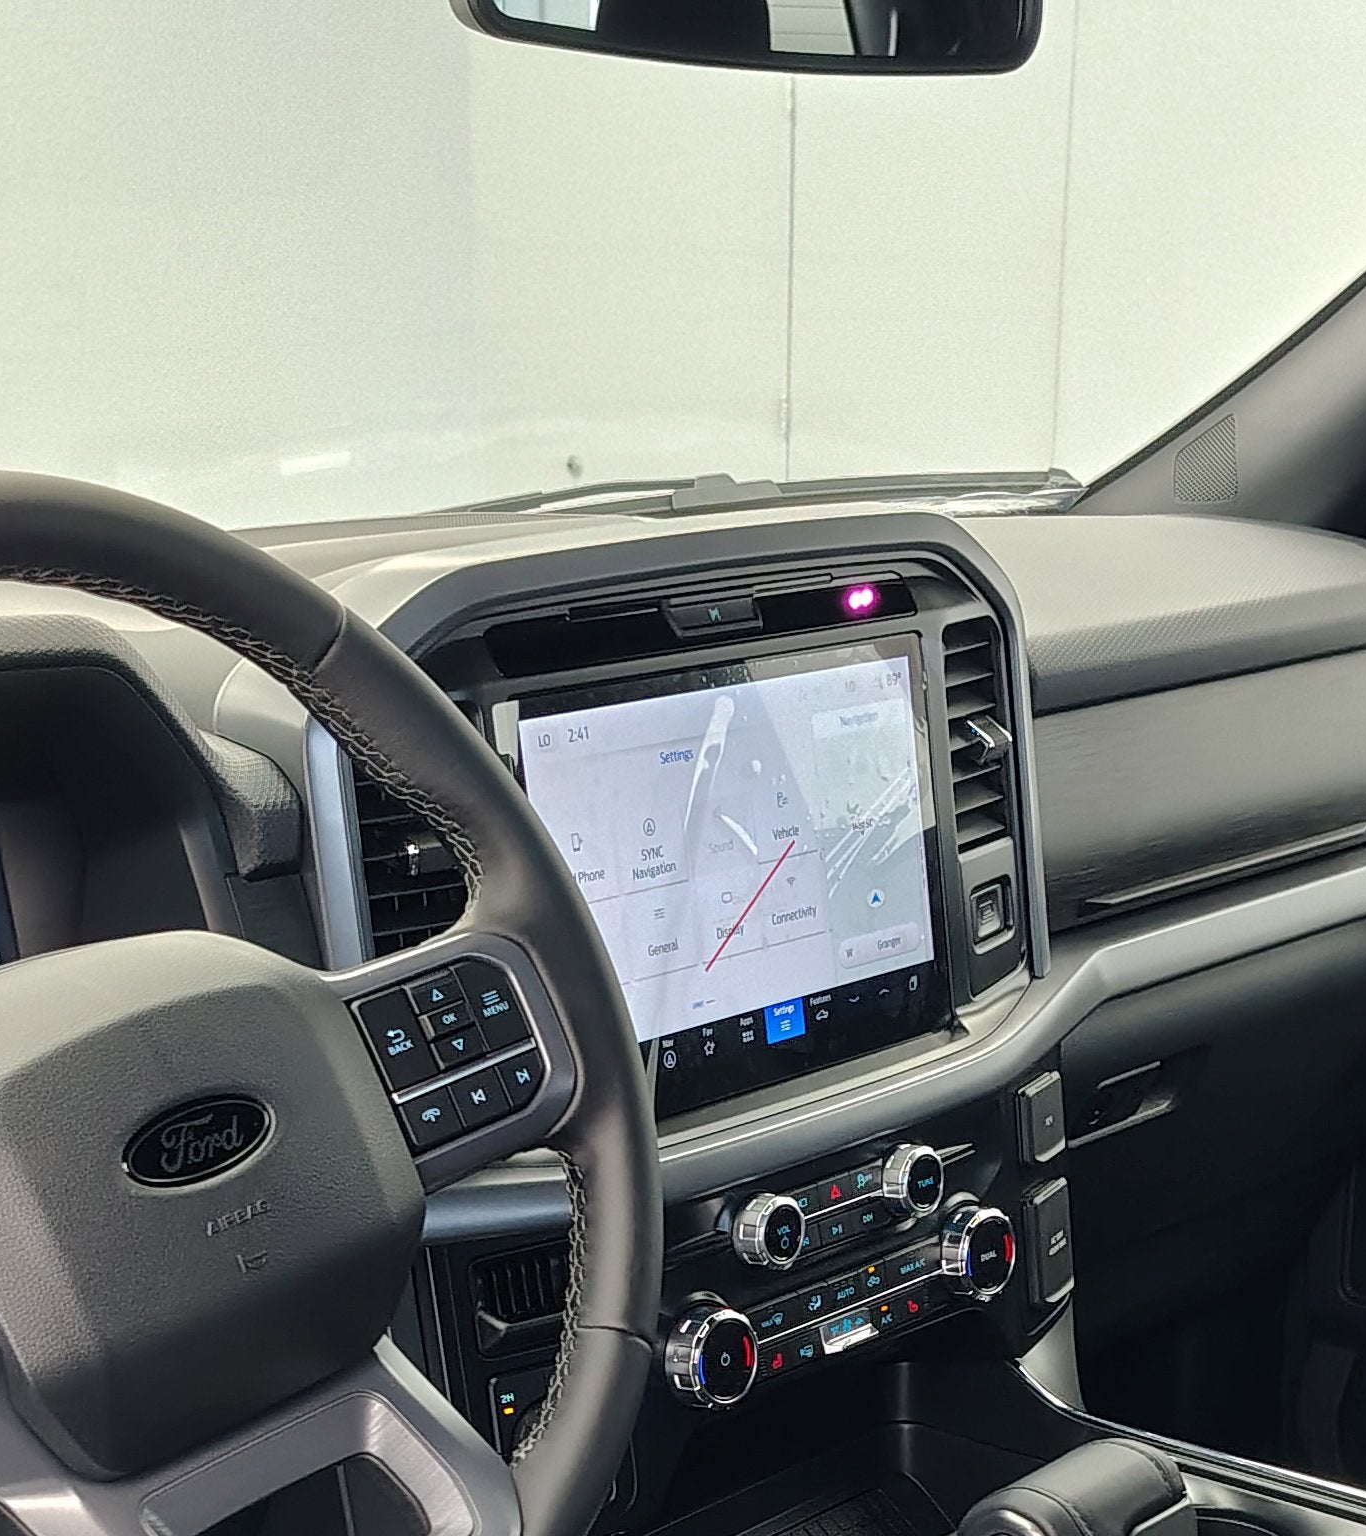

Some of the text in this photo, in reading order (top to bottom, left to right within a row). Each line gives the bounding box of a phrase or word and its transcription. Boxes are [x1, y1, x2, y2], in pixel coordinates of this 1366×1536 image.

[538, 725, 590, 748] LO 2:41
[659, 749, 694, 766] Settings
[772, 825, 800, 841] Vehicle
[641, 845, 665, 861] SYNC
[578, 868, 605, 884] Phone
[632, 861, 677, 880] Navigation
[771, 905, 817, 926] Connectivity
[716, 924, 745, 940] Display
[647, 938, 679, 957] General
[482, 1001, 510, 1018] MENU
[773, 1004, 795, 1017] Settings
[441, 1013, 458, 1025] OK
[387, 1039, 415, 1056] BACK
[161, 1112, 245, 1173] Ford
[777, 1225, 792, 1236] VOL
[837, 1286, 855, 1300] AUTO
[881, 1313, 893, 1325] A/C
[500, 1392, 515, 1404] 2H
